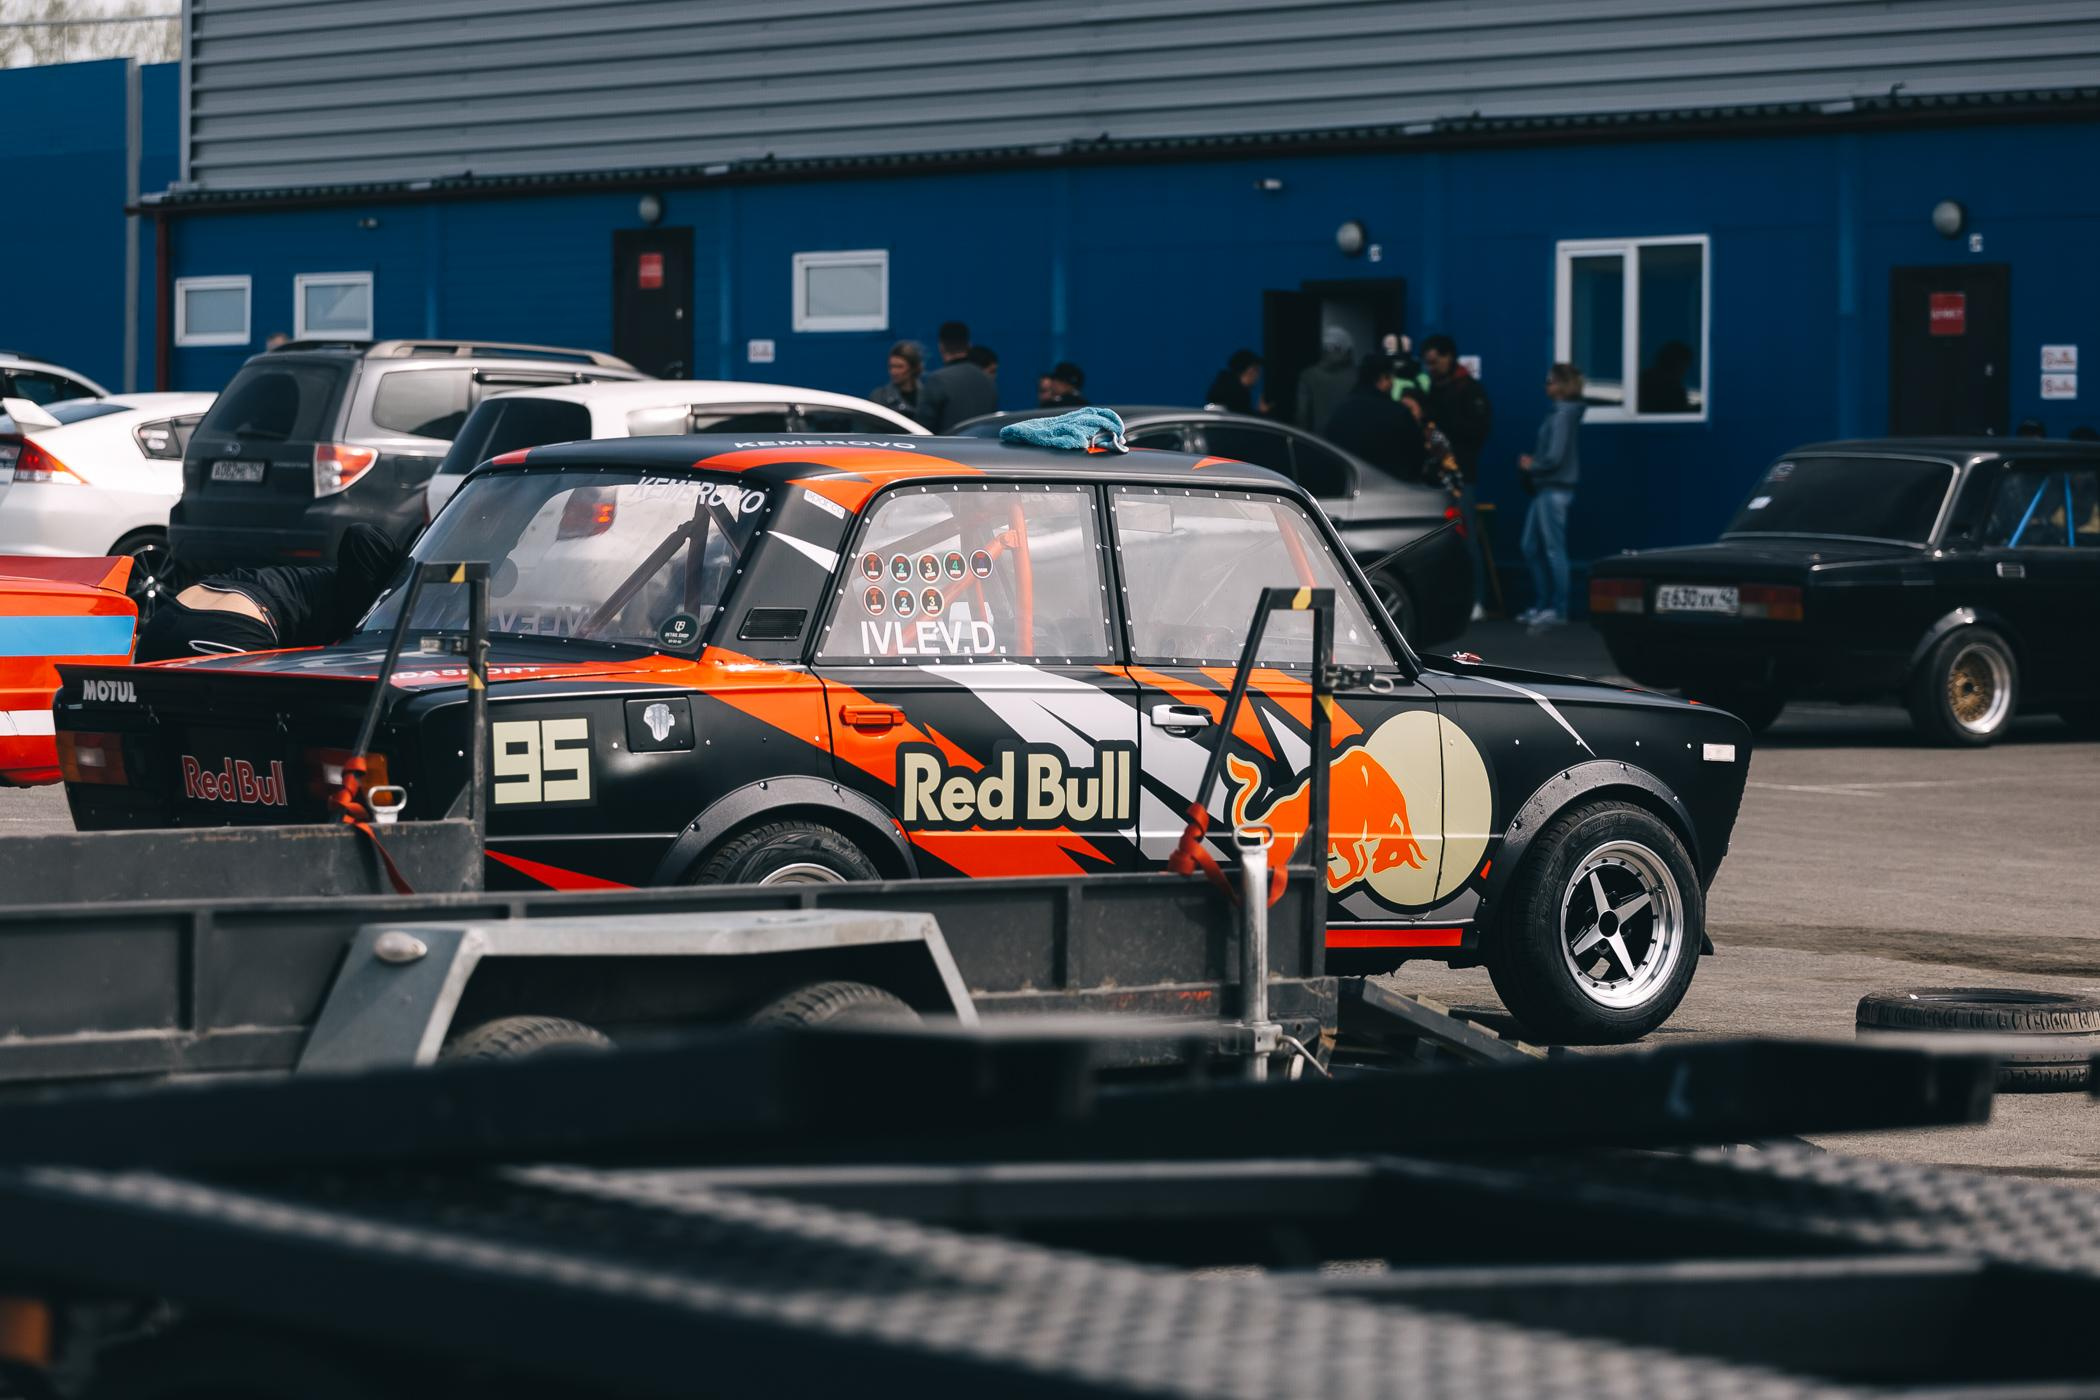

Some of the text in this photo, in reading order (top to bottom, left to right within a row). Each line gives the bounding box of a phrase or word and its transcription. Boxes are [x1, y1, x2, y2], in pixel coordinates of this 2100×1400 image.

[734, 440, 916, 449] KEMEROVO
[631, 476, 765, 514] KEMEROVO
[860, 621, 1006, 655] IVLEV.D.
[83, 680, 137, 702] MOTUL
[181, 755, 238, 802] Red
[493, 718, 590, 804] 95
[904, 750, 1130, 822] Red Bull
